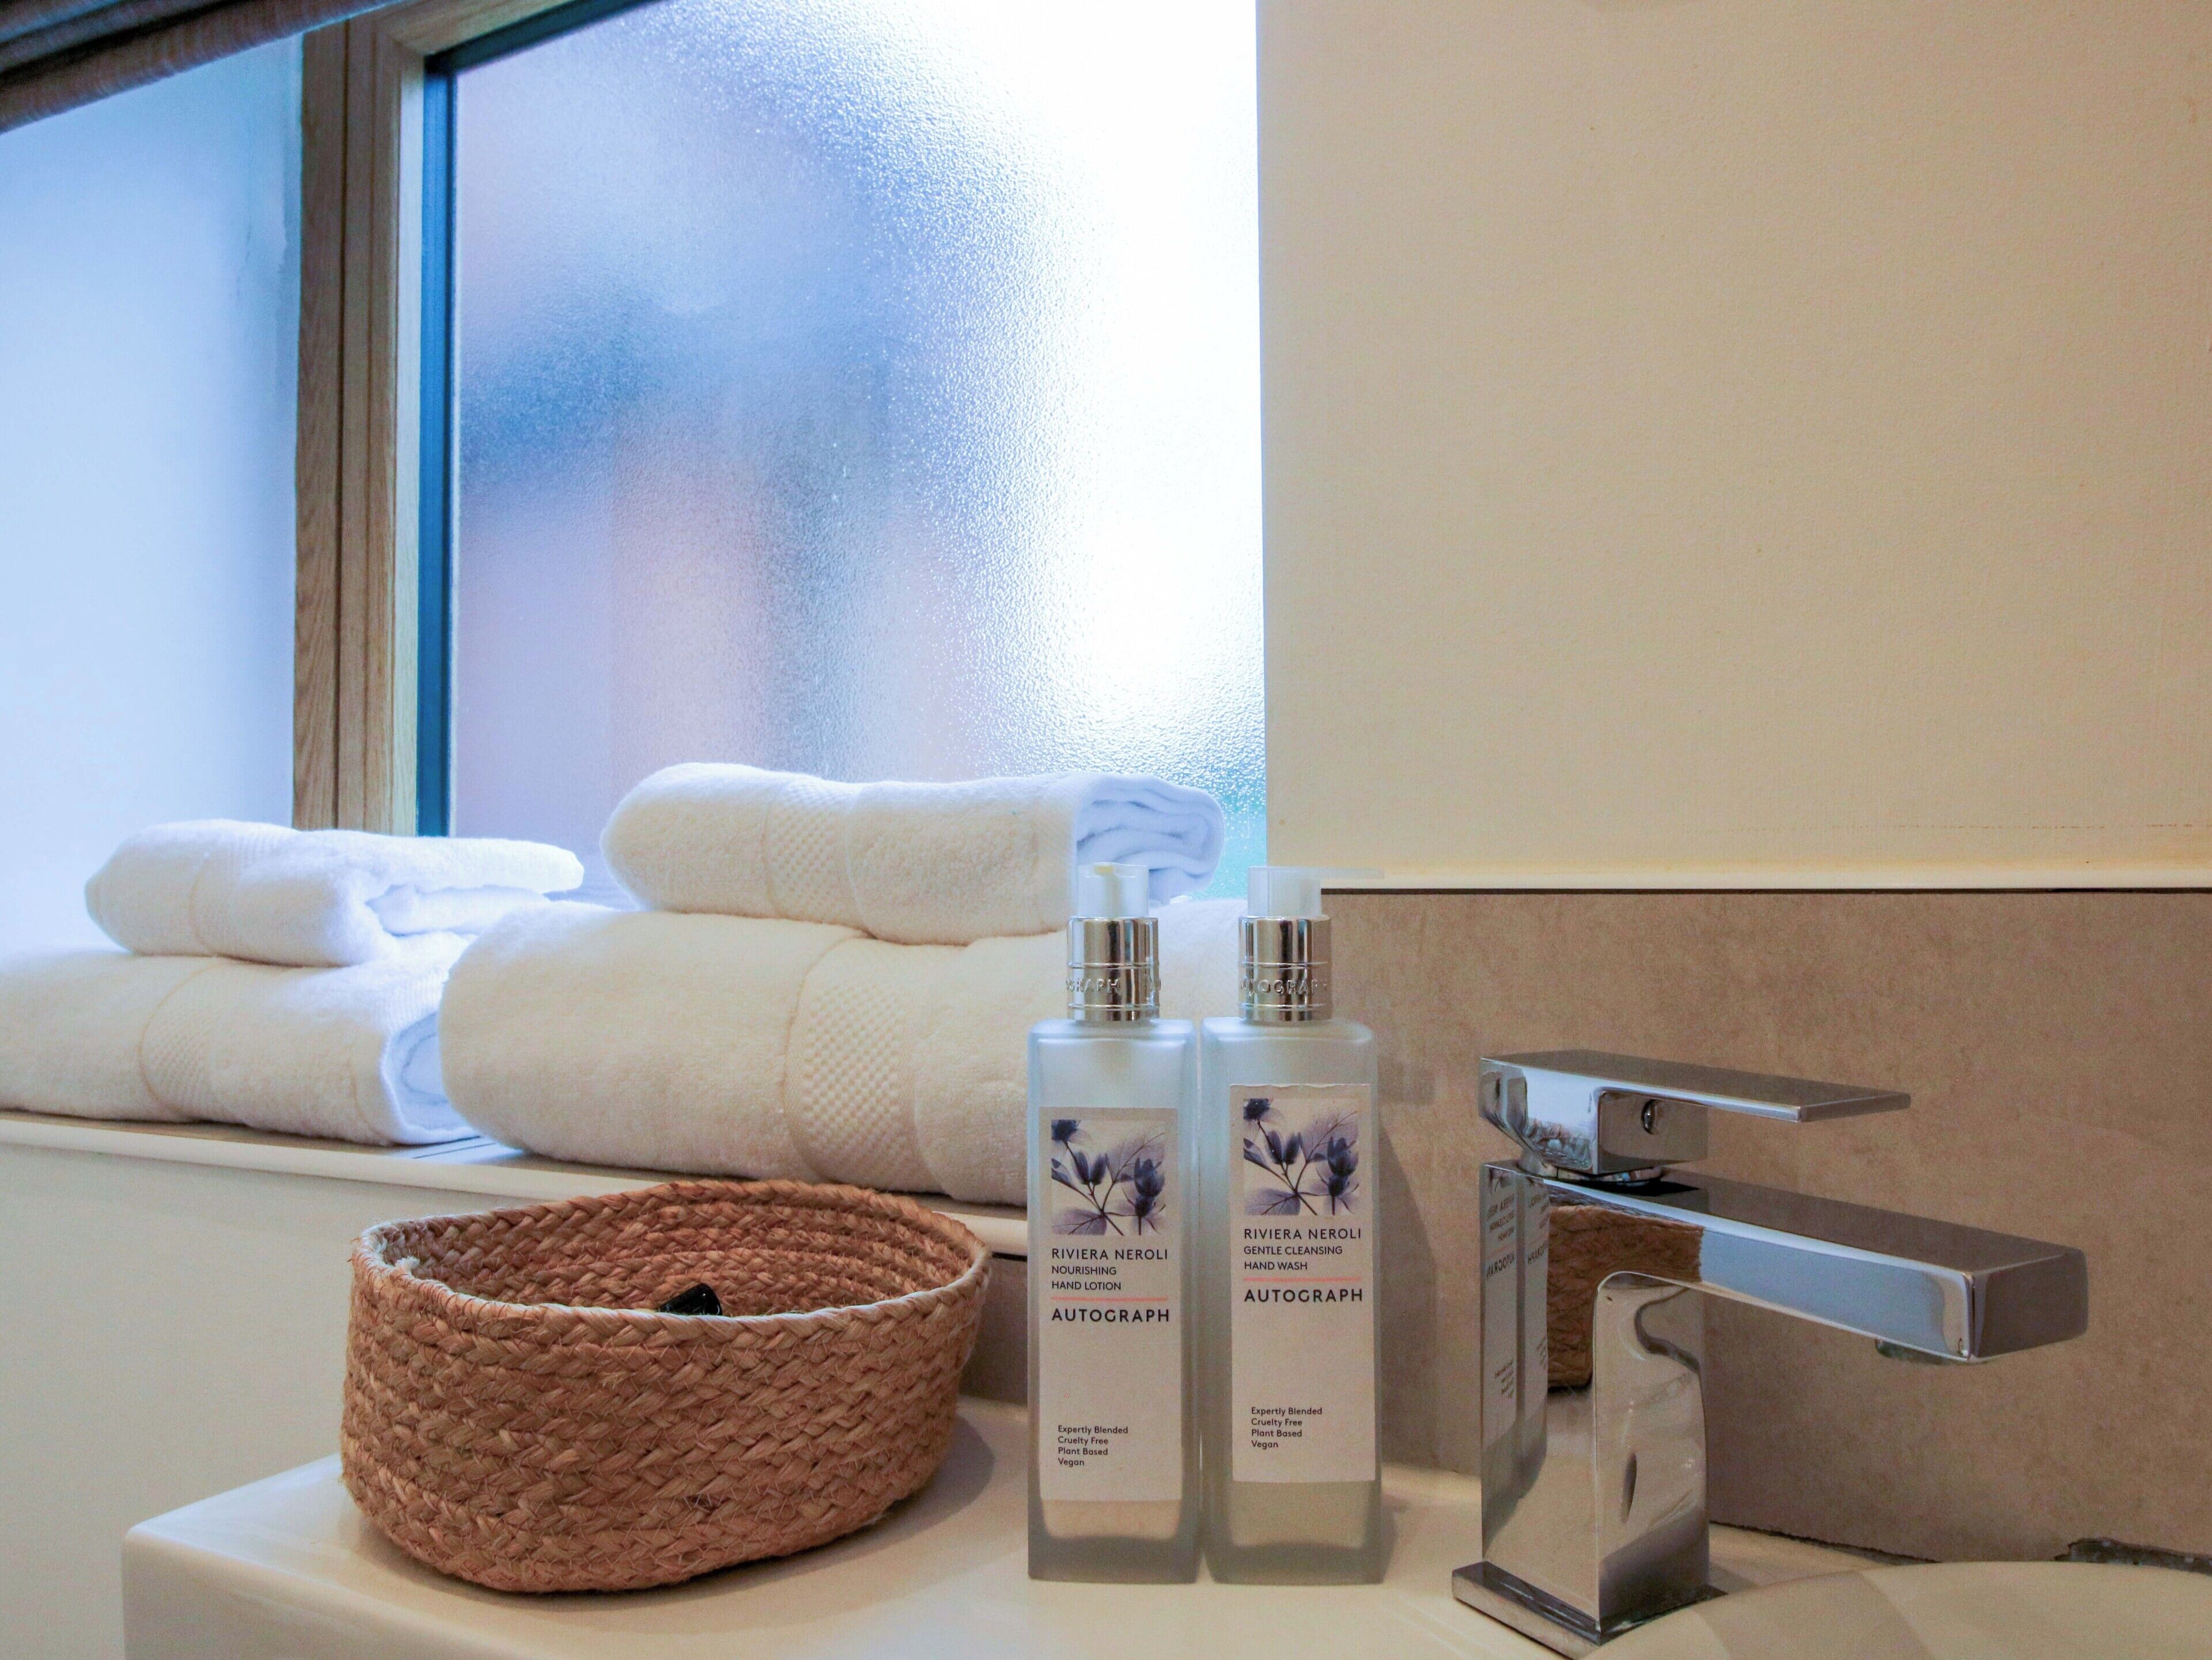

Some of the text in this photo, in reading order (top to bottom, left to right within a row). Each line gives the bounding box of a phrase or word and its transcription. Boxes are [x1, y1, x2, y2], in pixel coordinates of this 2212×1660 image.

[1244, 1228, 1361, 1240] RIVIERA NEROLI
[1052, 1248, 1168, 1260] RIVIERA NEROLI
[1244, 1246, 1343, 1255] GENTLE CLEANSING
[1052, 1265, 1117, 1275] NOURISHING
[1244, 1261, 1308, 1271] HAND WASH
[1052, 1280, 1122, 1291] HAND LOTION
[1244, 1288, 1362, 1303] AUTOGRAPH
[1051, 1308, 1169, 1322] AUTOGRAPH
[1251, 1407, 1323, 1417] Expertly Blended
[1251, 1418, 1302, 1428] Cruelty Free
[1058, 1424, 1128, 1435] Expertly Blended
[1251, 1428, 1302, 1437] Plant Based
[1058, 1435, 1108, 1446] Cruelty Free
[1251, 1440, 1279, 1450] Vegan
[1058, 1446, 1108, 1456] Plant Based
[1058, 1457, 1085, 1468] Vegan
